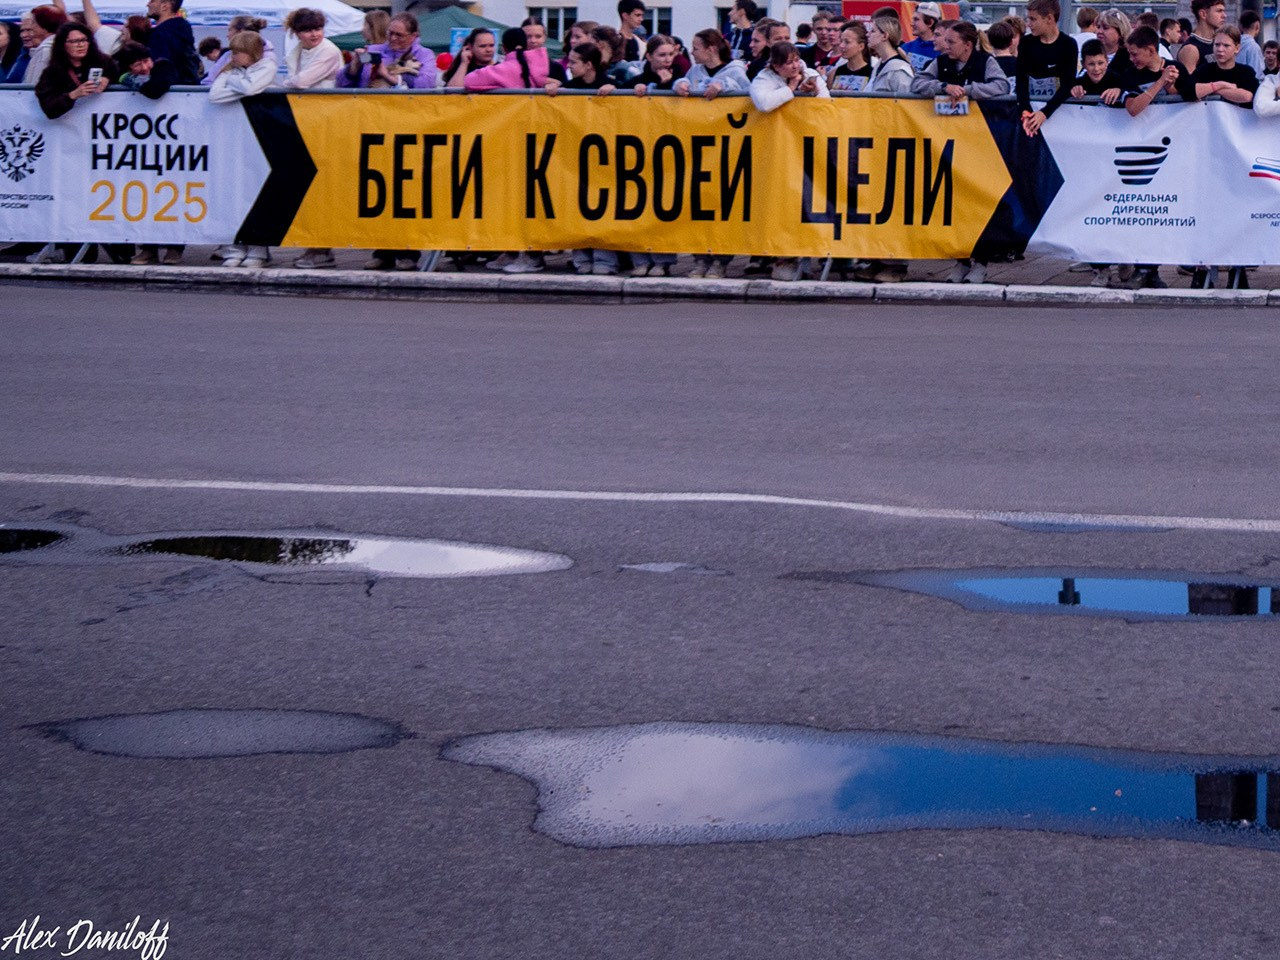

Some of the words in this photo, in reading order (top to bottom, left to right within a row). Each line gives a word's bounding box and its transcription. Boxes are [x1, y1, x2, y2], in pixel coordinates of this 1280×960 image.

[91, 113, 179, 141] КРОСС
[91, 143, 209, 176] НАЦИИ
[357, 133, 484, 220] БЕГИ
[525, 132, 558, 220] К
[577, 112, 753, 222] СВОЕЙ
[800, 135, 956, 241] ЦЕЛИ
[88, 179, 208, 223] 2025
[1103, 193, 1178, 204] ФЕДЕРАЛЬНАЯ
[1111, 205, 1169, 216] ДИРЕКЦИЯ
[1083, 216, 1196, 227] СПОРТМЕРОПРИЯТИЙ
